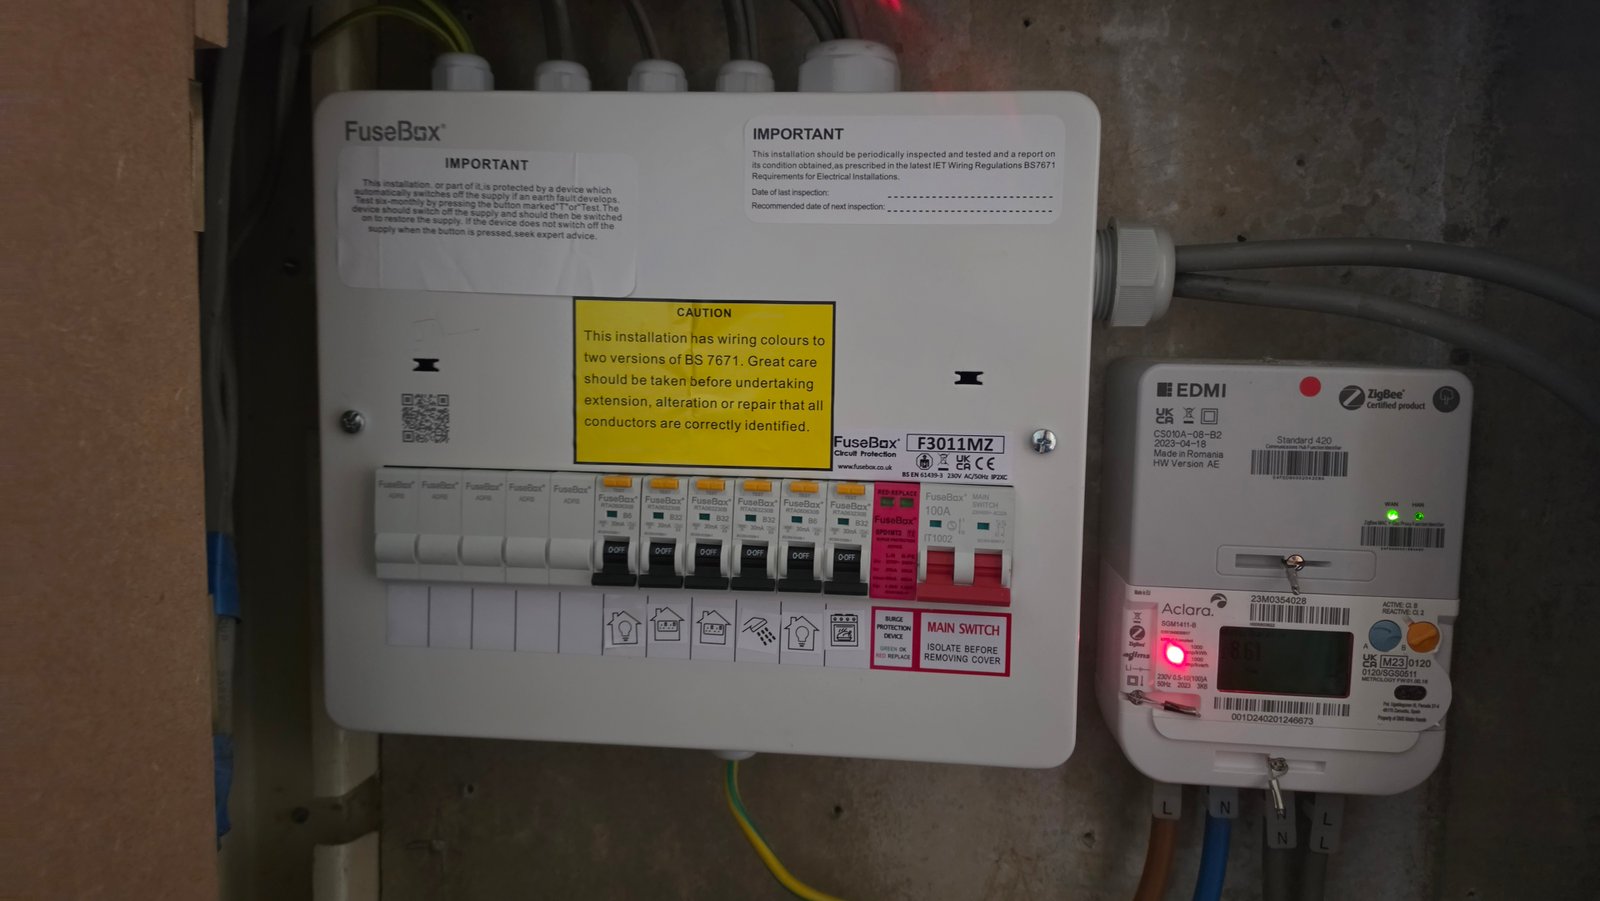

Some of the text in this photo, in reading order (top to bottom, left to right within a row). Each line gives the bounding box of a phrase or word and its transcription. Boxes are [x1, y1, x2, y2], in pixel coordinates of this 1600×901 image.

[345, 120, 441, 141] FuseBox
[753, 128, 844, 140] IMPORTANT
[857, 150, 904, 159] periodically
[1017, 150, 1044, 159] report
[445, 158, 528, 170] IMPORTANT
[844, 162, 886, 170] prescribed
[947, 161, 973, 170] Wiring
[974, 161, 1022, 170] Regulations
[752, 172, 804, 180] Requirements
[470, 210, 499, 219] supply
[570, 212, 583, 220] be
[582, 213, 622, 221] switched
[677, 308, 732, 318] CAUTION
[584, 330, 825, 347] This installation has wiring colours to
[584, 352, 817, 367] two versions of BS 7671. Great care
[584, 375, 814, 391] should be taken before undertaking
[1177, 383, 1226, 398] EDMI
[1368, 388, 1402, 400] ZigBee
[584, 396, 823, 411] extension, alteration or repair that all
[1367, 401, 1426, 411] Certified product
[584, 418, 810, 432] conductors are correctly identified.
[1154, 430, 1222, 439] CS010A-08-B2
[1276, 436, 1332, 444] Standard 420
[834, 436, 897, 449] FuseBox
[918, 436, 994, 452] F3011MZ
[1154, 440, 1207, 448] 2023-04-18
[1154, 449, 1178, 457] Made
[1187, 450, 1224, 458] Romania
[925, 492, 964, 502] FuseBox
[925, 506, 951, 516] 100A
[924, 534, 953, 544] IT1002
[1251, 595, 1307, 605] 23M0354028
[928, 622, 1000, 636] MAIN SWITCH
[927, 643, 998, 654] ISOLATE BEFORE
[924, 653, 1001, 665] REMOVING COVER
[1383, 658, 1431, 668] M23 0120
[1362, 669, 1417, 678] 0120/SGS0511
[1232, 713, 1314, 725] 001D240201246673
[1163, 801, 1172, 815] L
[1221, 801, 1230, 814] N
[1323, 812, 1333, 825] L
[1278, 832, 1288, 845] N
[1320, 836, 1329, 849] L
